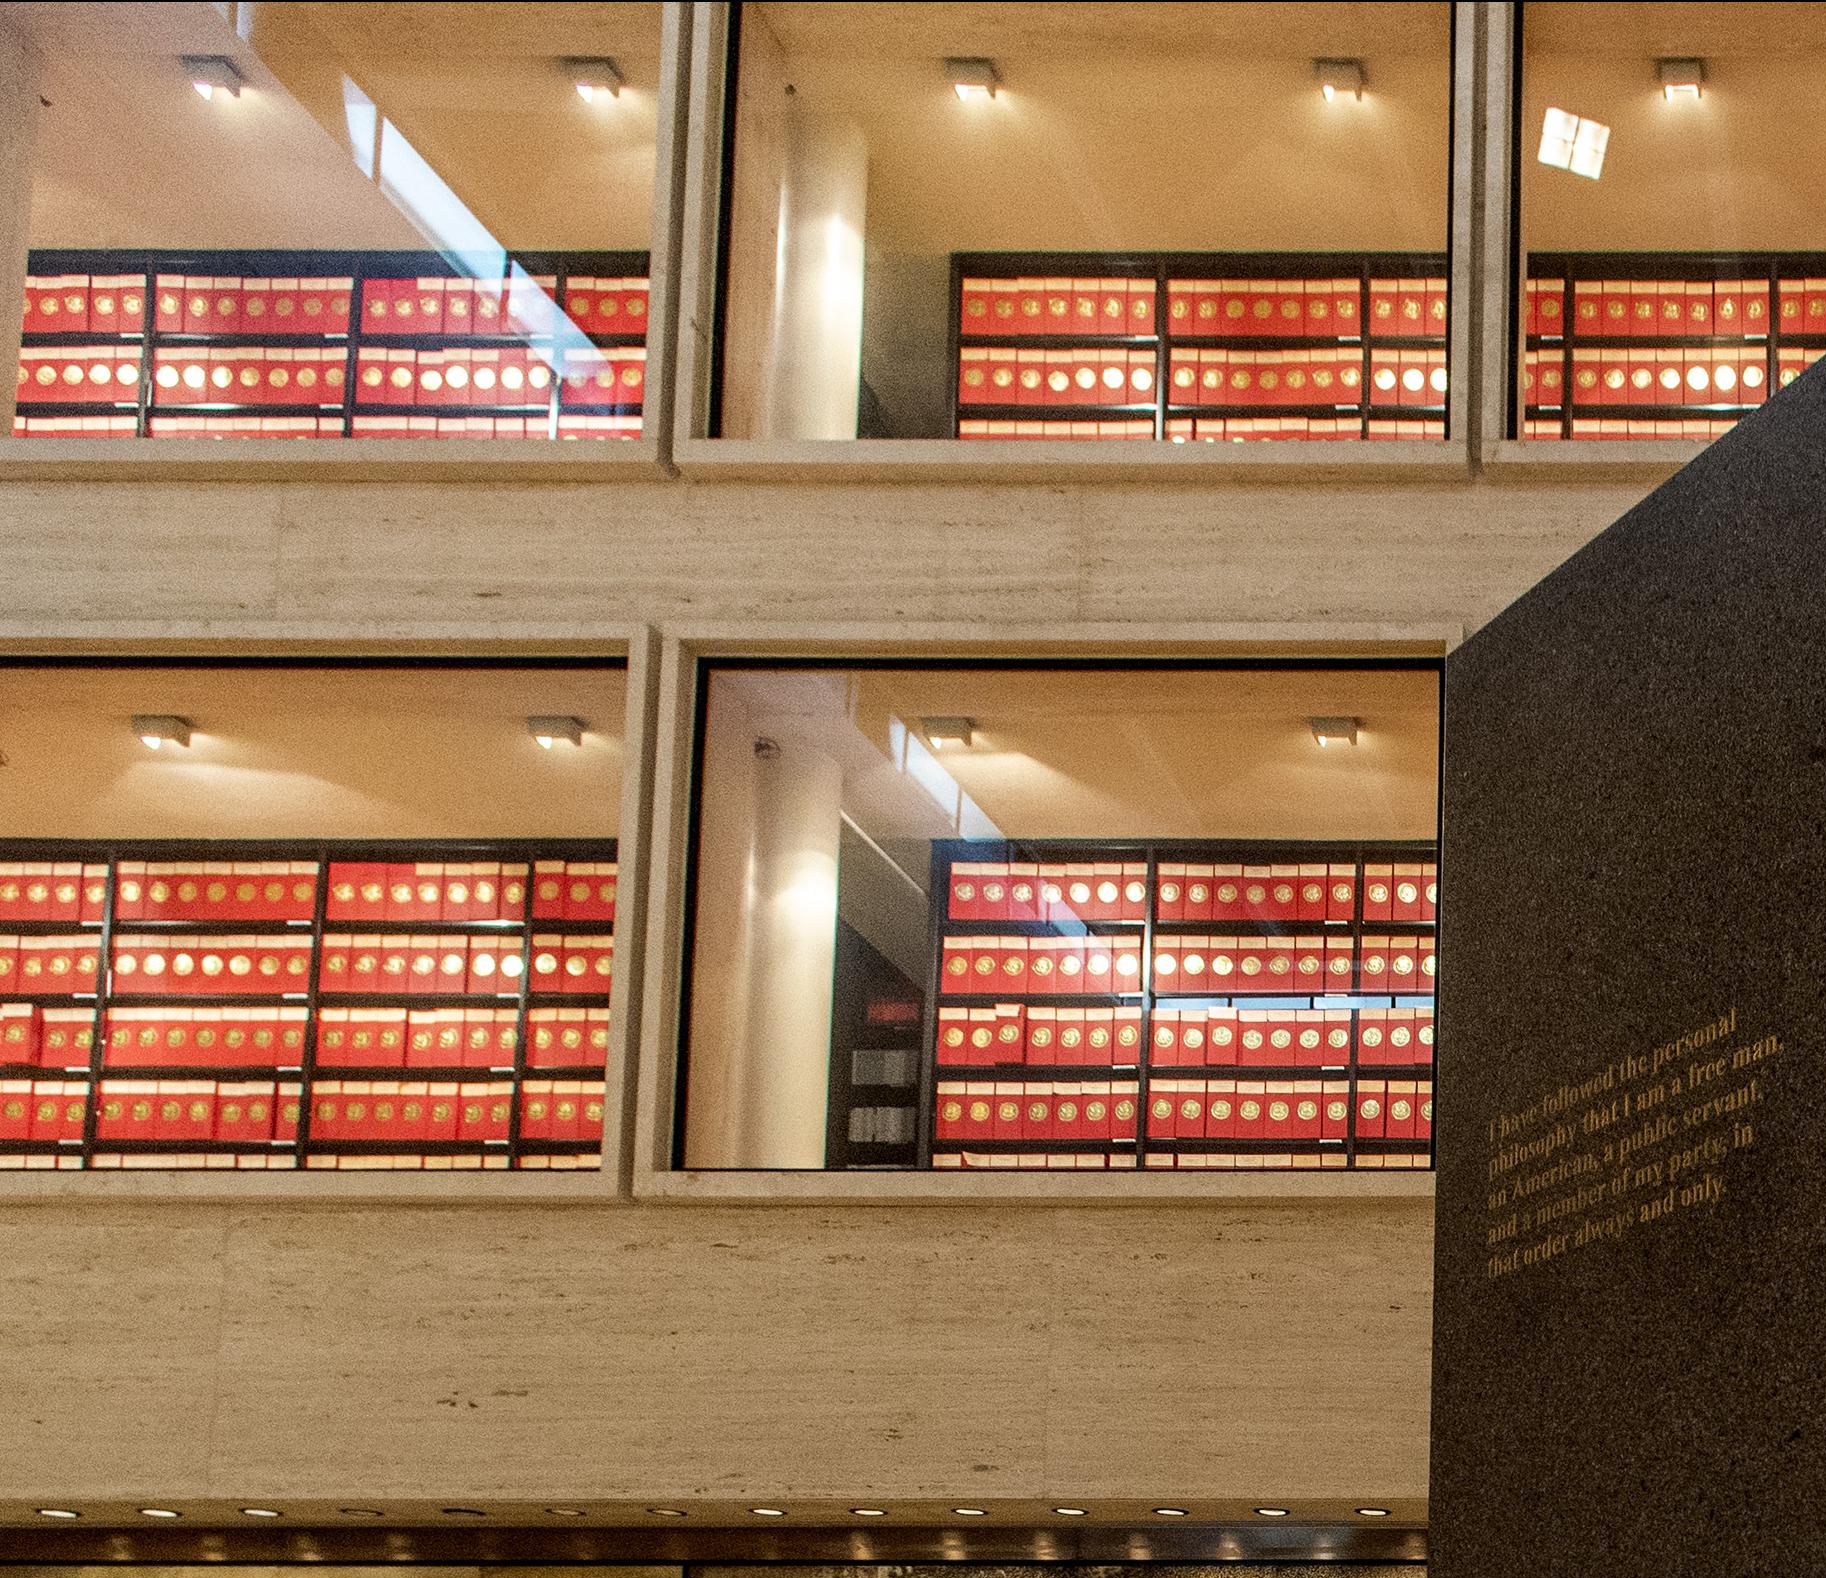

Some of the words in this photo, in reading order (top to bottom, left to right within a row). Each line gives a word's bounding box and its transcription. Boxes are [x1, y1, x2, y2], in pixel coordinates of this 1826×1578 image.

[1489, 1119, 1497, 1142] I
[1500, 1107, 1538, 1138] have
[1543, 1063, 1615, 1117] followed
[1620, 1054, 1647, 1081] the
[1653, 1007, 1736, 1075] personal
[1489, 1122, 1577, 1182] philosophy
[1583, 1100, 1619, 1135] that
[1623, 1091, 1631, 1119] I
[1636, 1084, 1664, 1111] am
[1671, 1077, 1681, 1096] a
[1689, 1058, 1727, 1090] free
[1733, 1034, 1784, 1070] man,
[1488, 1189, 1508, 1211] an
[1603, 1144, 1613, 1163] a
[1620, 1114, 1678, 1165] public
[1488, 1213, 1518, 1244] and
[1523, 1214, 1532, 1232] a
[1537, 1183, 1606, 1225] member
[1611, 1167, 1631, 1197] of
[1635, 1161, 1662, 1188] my
[1669, 1135, 1728, 1182] party,
[1734, 1122, 1753, 1149] in
[1488, 1247, 1520, 1280] that
[1524, 1233, 1569, 1265] order
[1640, 1186, 1674, 1222] and
